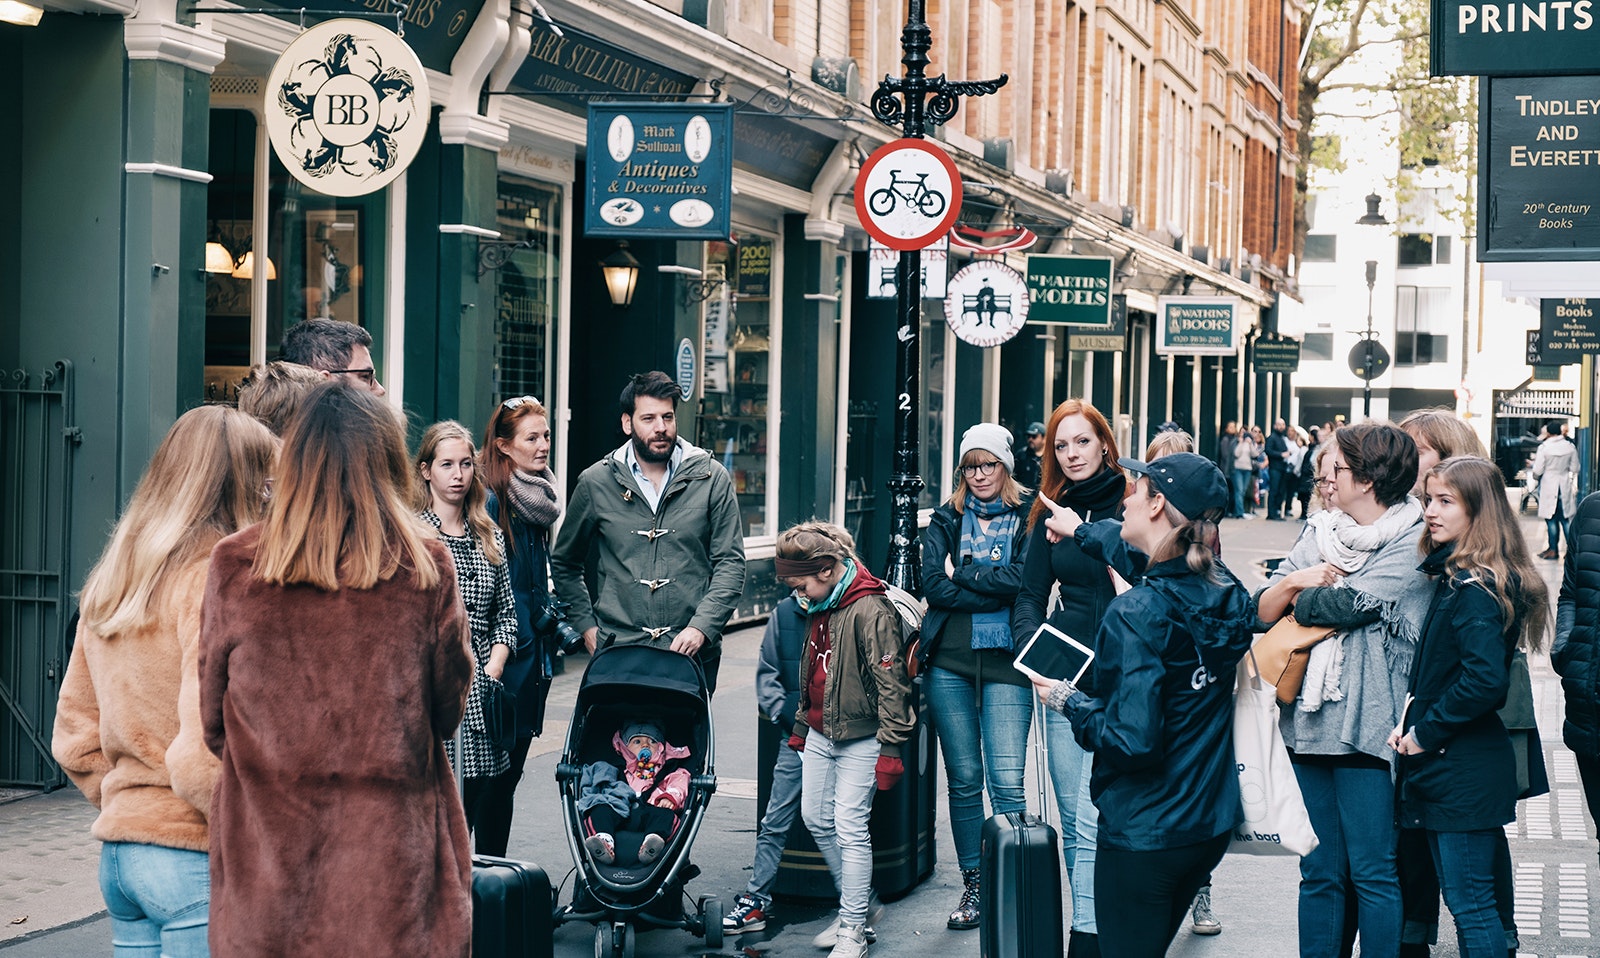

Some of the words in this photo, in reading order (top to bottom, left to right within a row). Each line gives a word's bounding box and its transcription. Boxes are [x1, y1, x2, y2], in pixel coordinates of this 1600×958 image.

[1458, 0, 1593, 34] PRINTS
[530, 26, 569, 66] ARK
[564, 43, 646, 92] SULLIVAN
[324, 94, 369, 125] BB
[1515, 95, 1600, 116] TINDLEY
[643, 126, 675, 138] Mark
[1536, 125, 1579, 141] AND
[636, 140, 681, 153] Sullivan
[618, 160, 699, 181] Antiques
[607, 180, 619, 193] &
[624, 181, 708, 194] Decoratives
[1522, 203, 1545, 214] 20th
[1547, 203, 1591, 215] Century
[1539, 218, 1574, 229] Books
[869, 249, 947, 261] ANTUES
[977, 260, 1022, 285] LONDON
[1039, 274, 1108, 290] MARTINS
[1030, 288, 1107, 306] MODELS
[1181, 308, 1231, 320] WATKINS
[1556, 305, 1593, 317] Books
[1182, 318, 1231, 332] BOOKS
[1078, 337, 1116, 349] MUSIC
[899, 393, 911, 410] 2
[1253, 830, 1281, 844] bag
